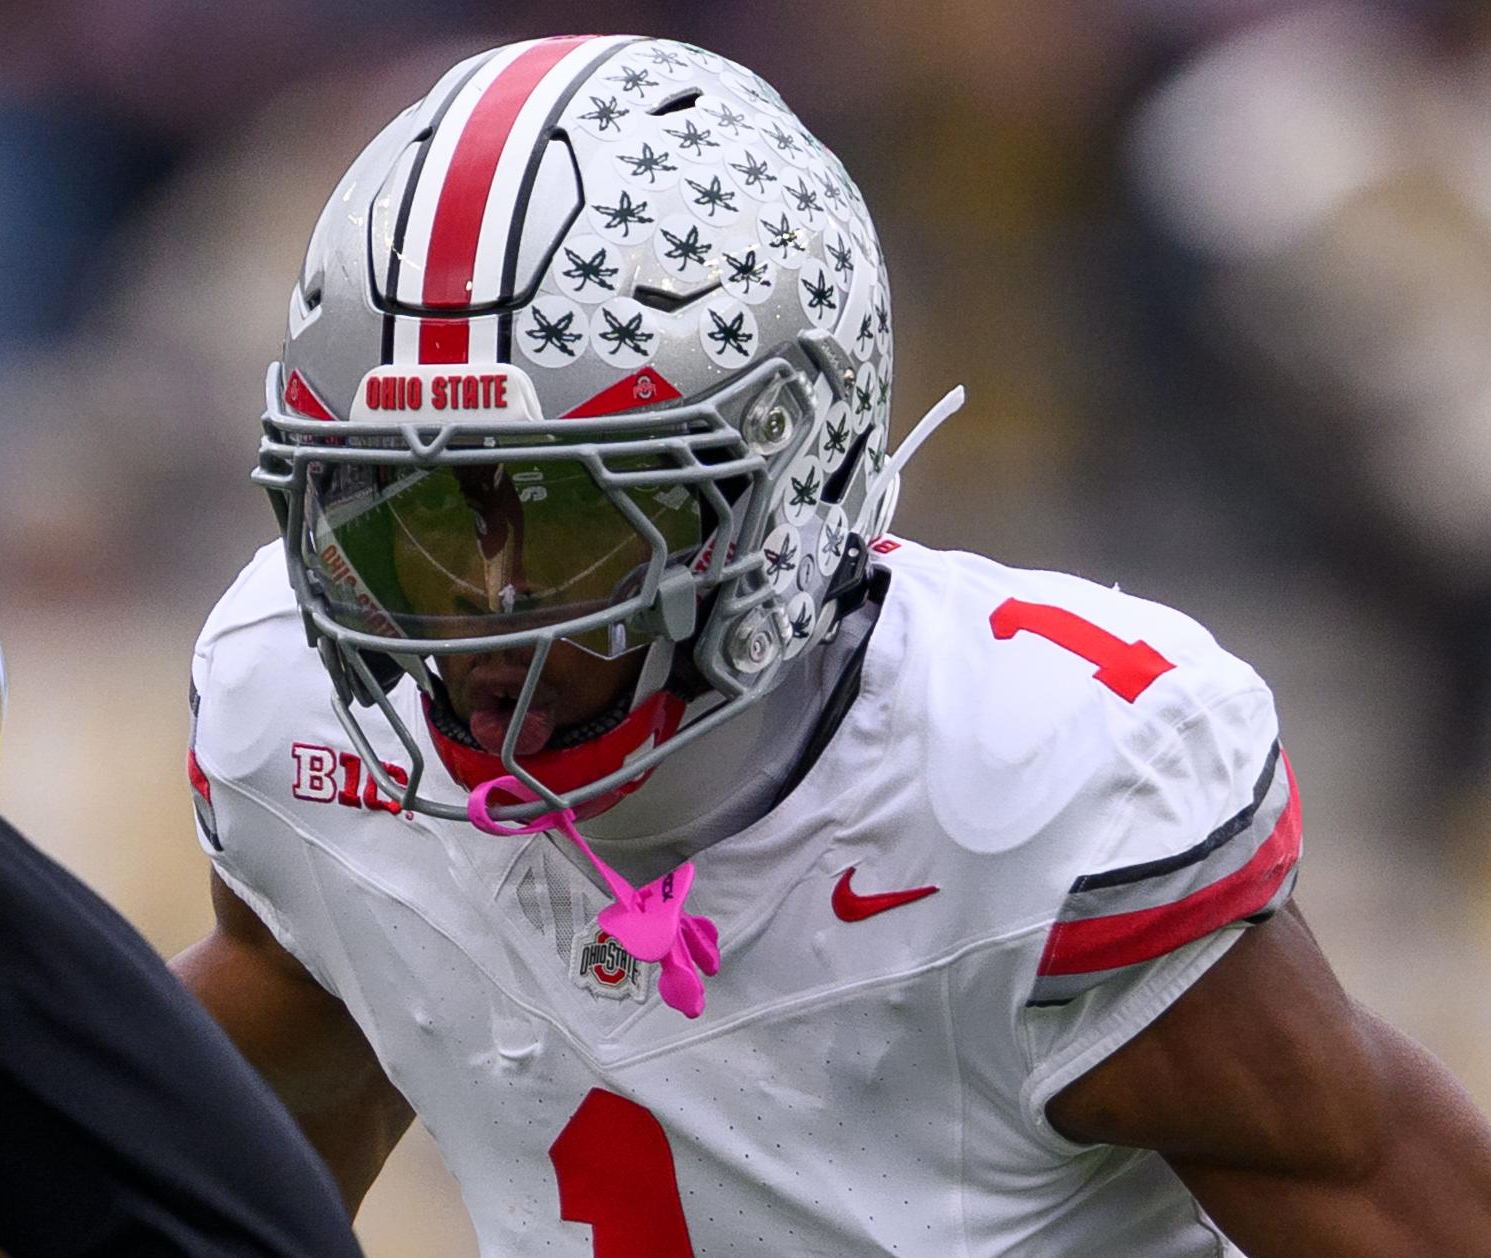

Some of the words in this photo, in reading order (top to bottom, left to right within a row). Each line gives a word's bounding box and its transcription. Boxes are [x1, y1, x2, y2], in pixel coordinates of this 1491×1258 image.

[366, 376, 422, 411] OHIO
[431, 375, 508, 411] STATE
[989, 597, 1177, 704] 1
[580, 944, 607, 976] OHIO
